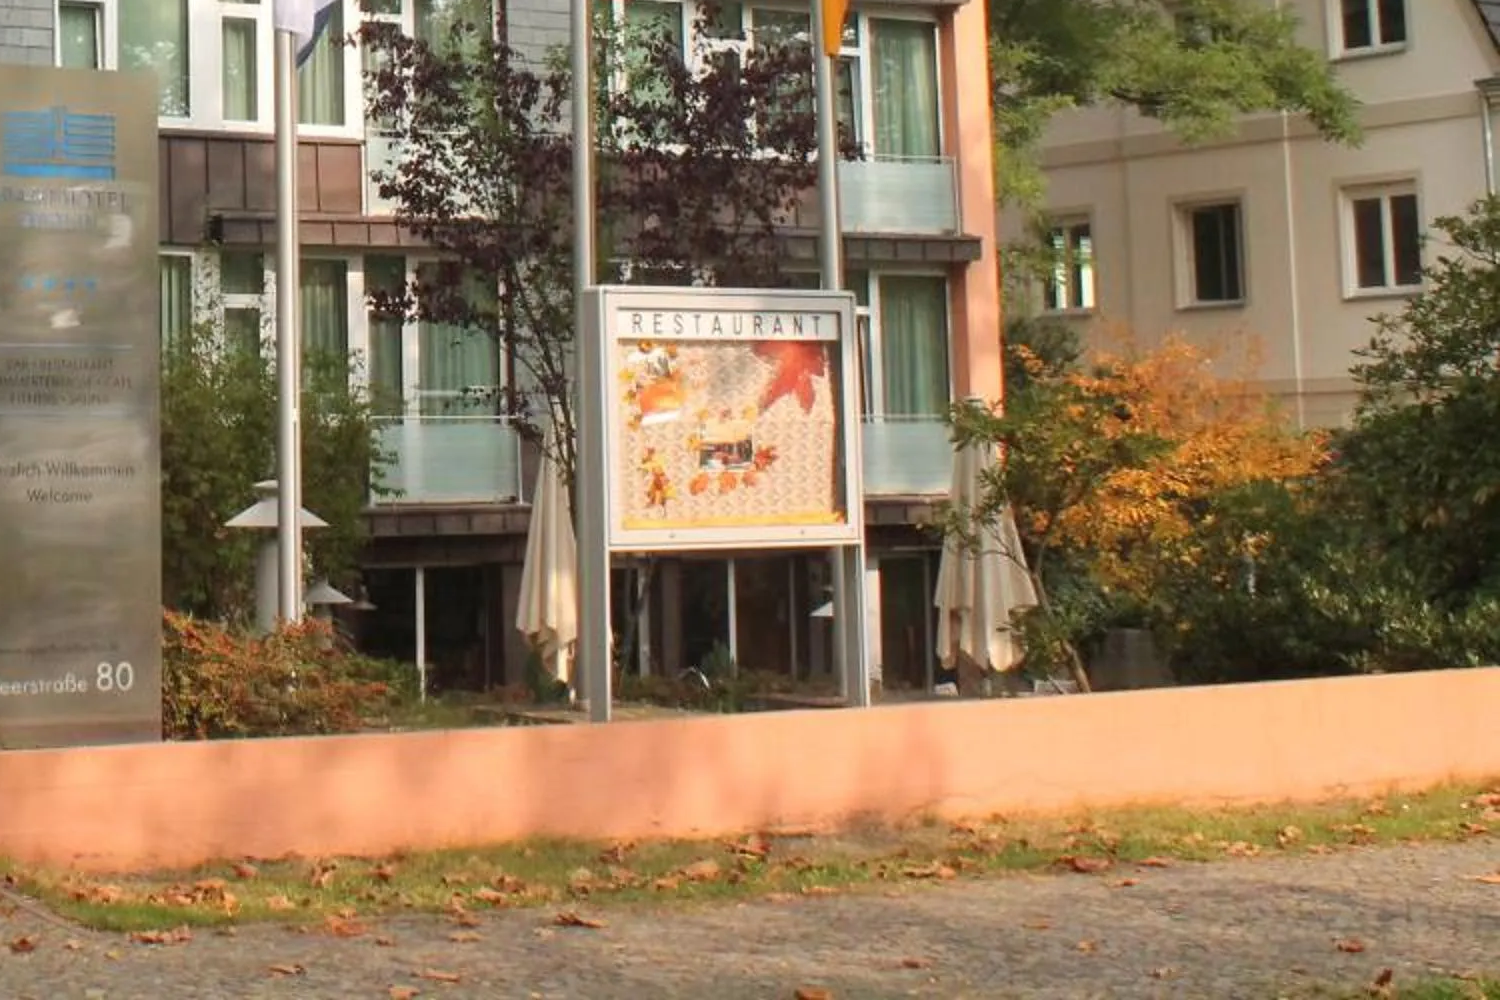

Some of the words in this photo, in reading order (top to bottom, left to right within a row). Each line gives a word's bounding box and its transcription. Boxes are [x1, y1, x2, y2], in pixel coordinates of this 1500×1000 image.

[631, 312, 822, 336] RESTAURANT
[45, 460, 137, 479] Willkommen
[26, 487, 94, 503] Welcome
[95, 660, 135, 692] 80
